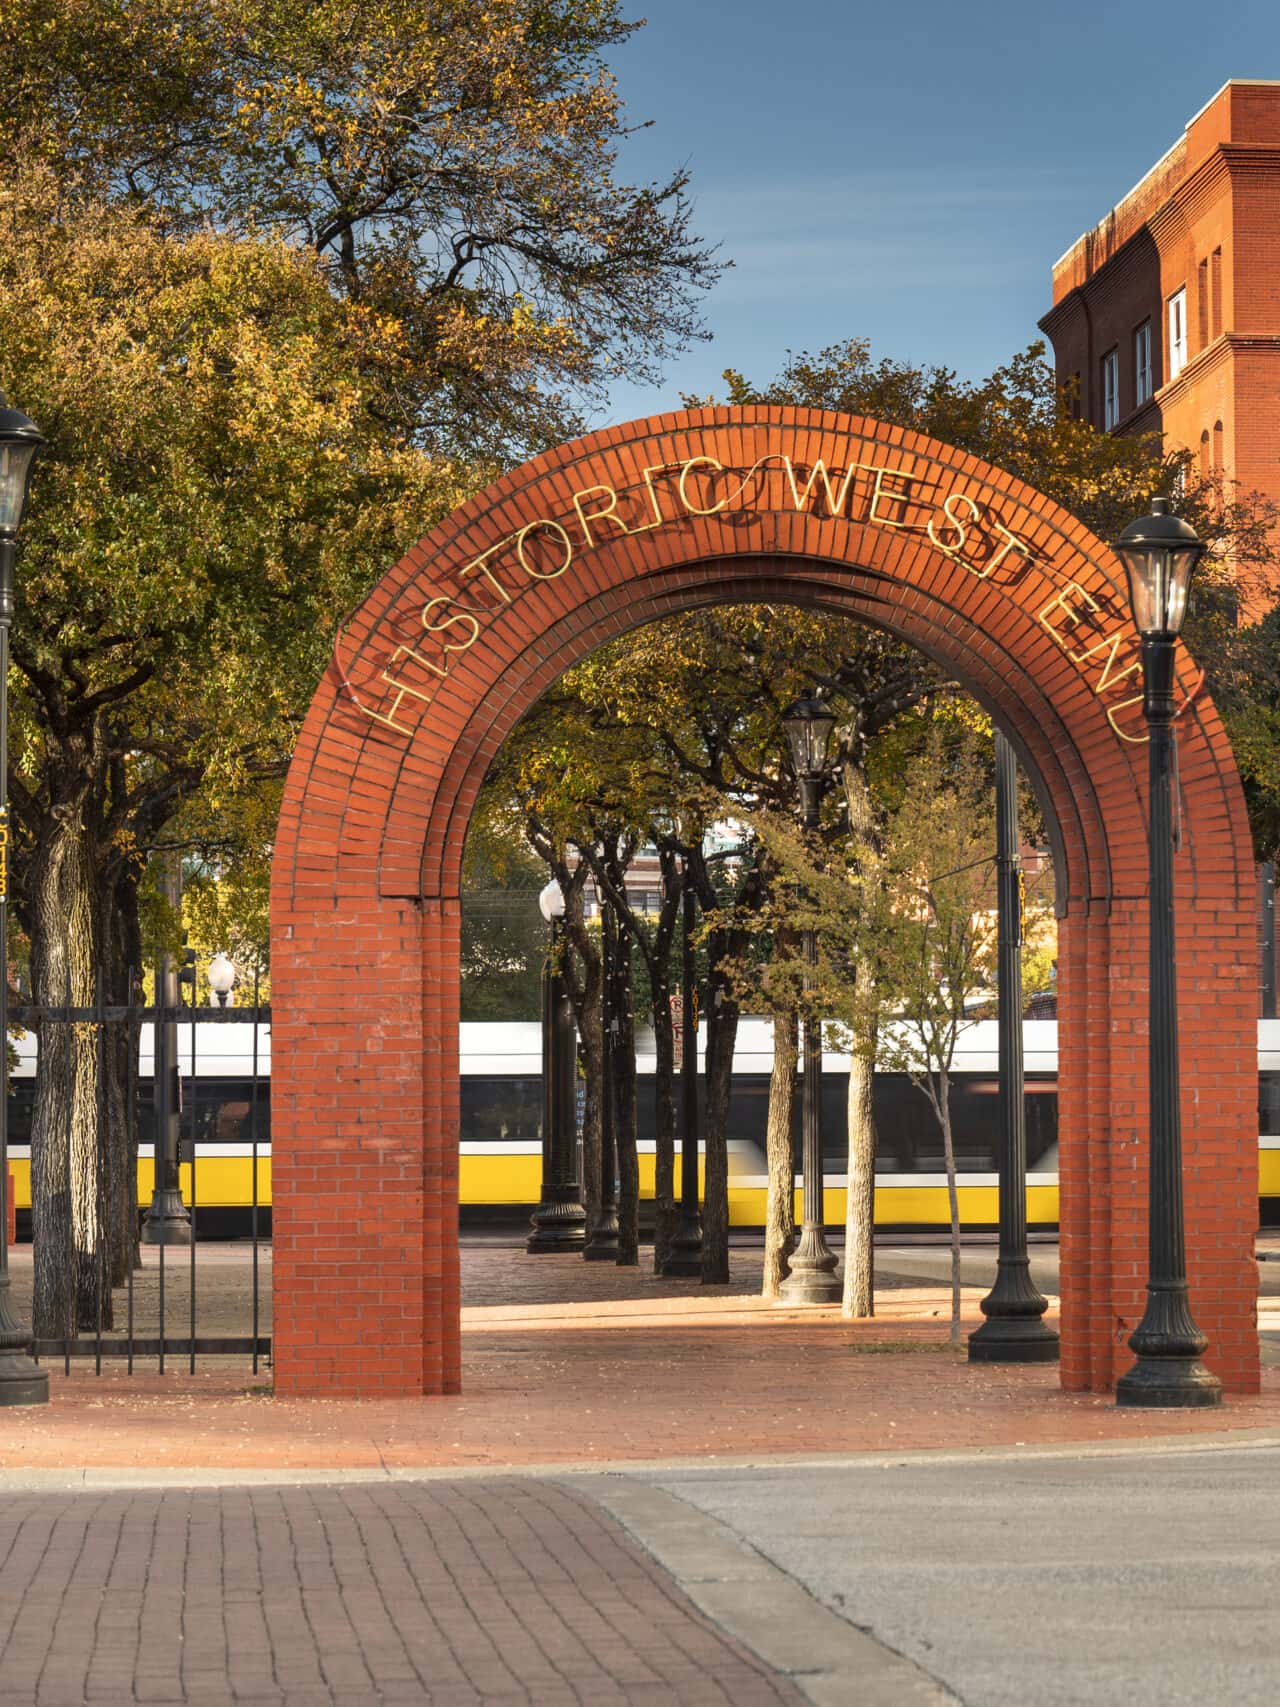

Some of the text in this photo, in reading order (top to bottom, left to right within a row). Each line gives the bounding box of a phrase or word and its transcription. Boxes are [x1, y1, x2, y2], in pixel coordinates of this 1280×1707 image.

[359, 456, 1152, 743] HISTORIC WEST END
